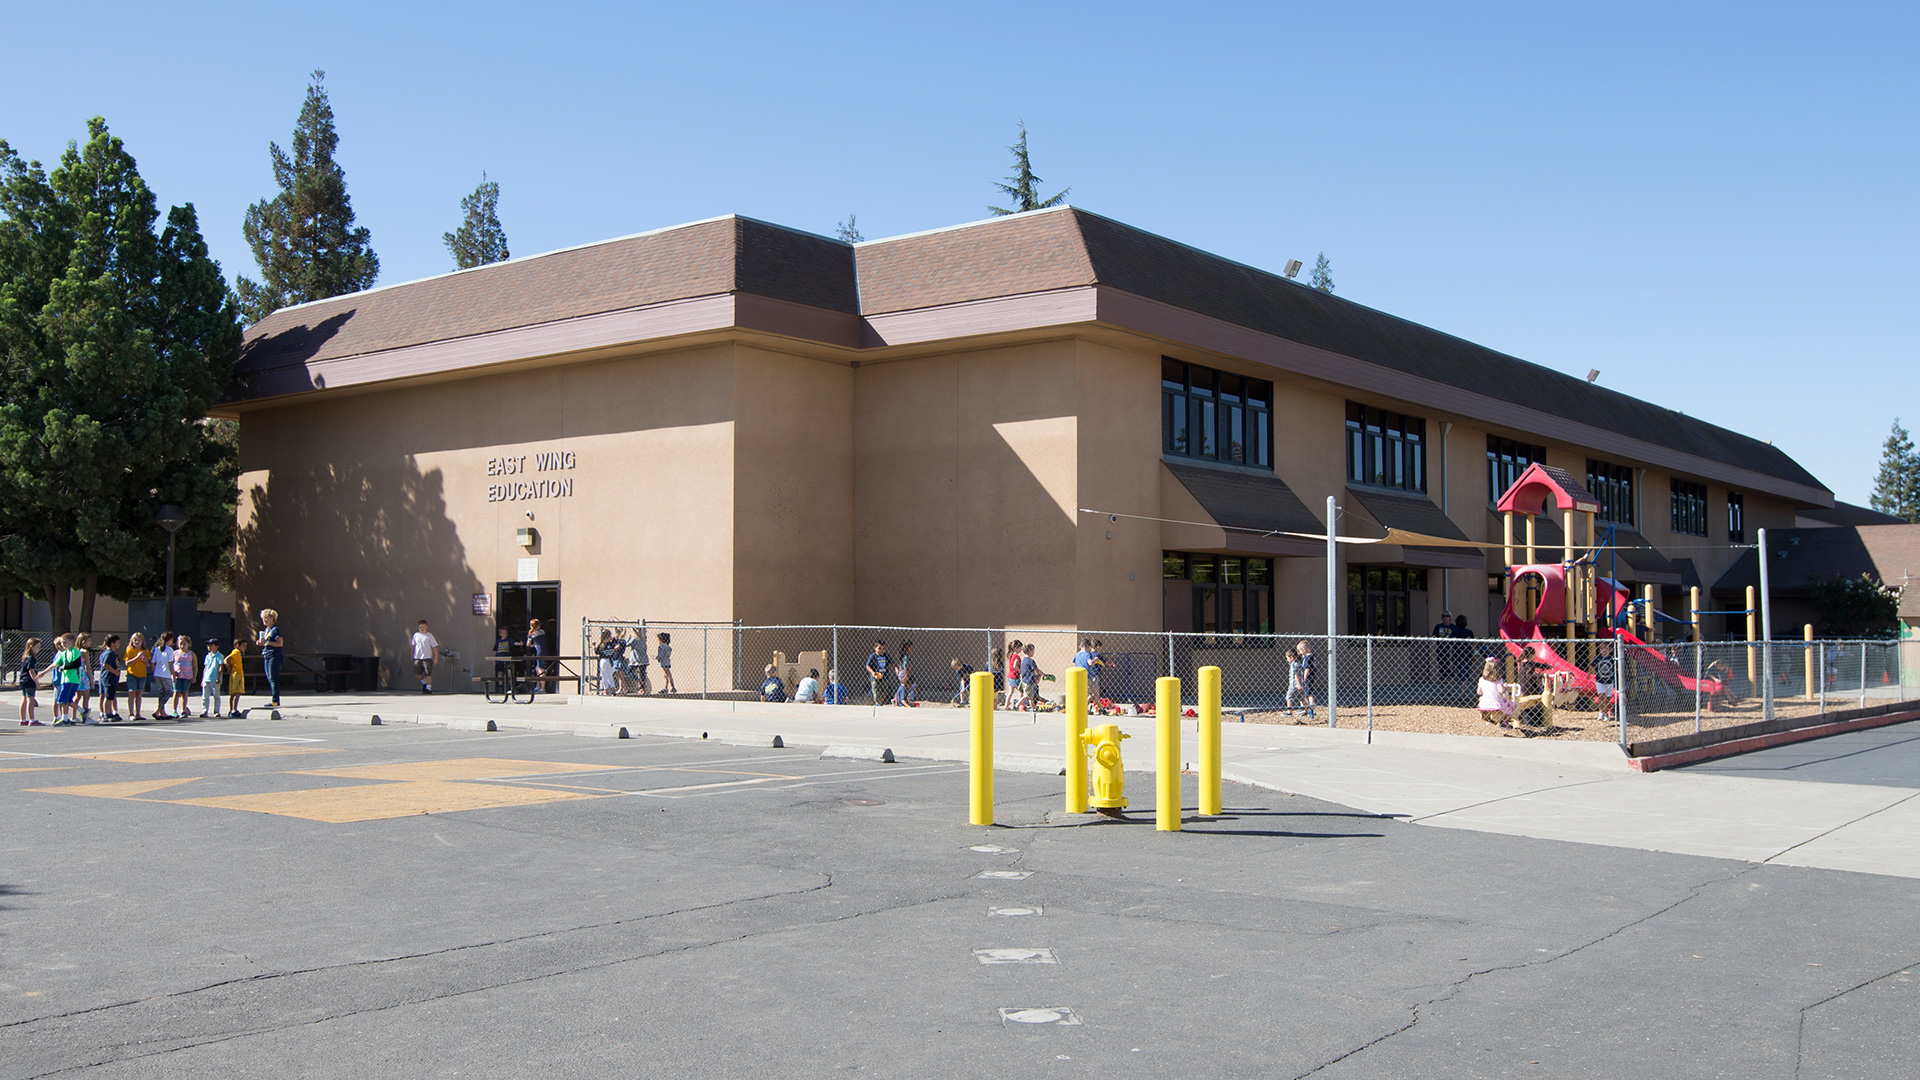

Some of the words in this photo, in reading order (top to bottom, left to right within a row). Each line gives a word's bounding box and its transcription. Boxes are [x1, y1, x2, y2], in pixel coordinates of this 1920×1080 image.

[487, 455, 526, 476] EAST
[535, 451, 576, 471] WING
[487, 478, 573, 502] EDUCATION
